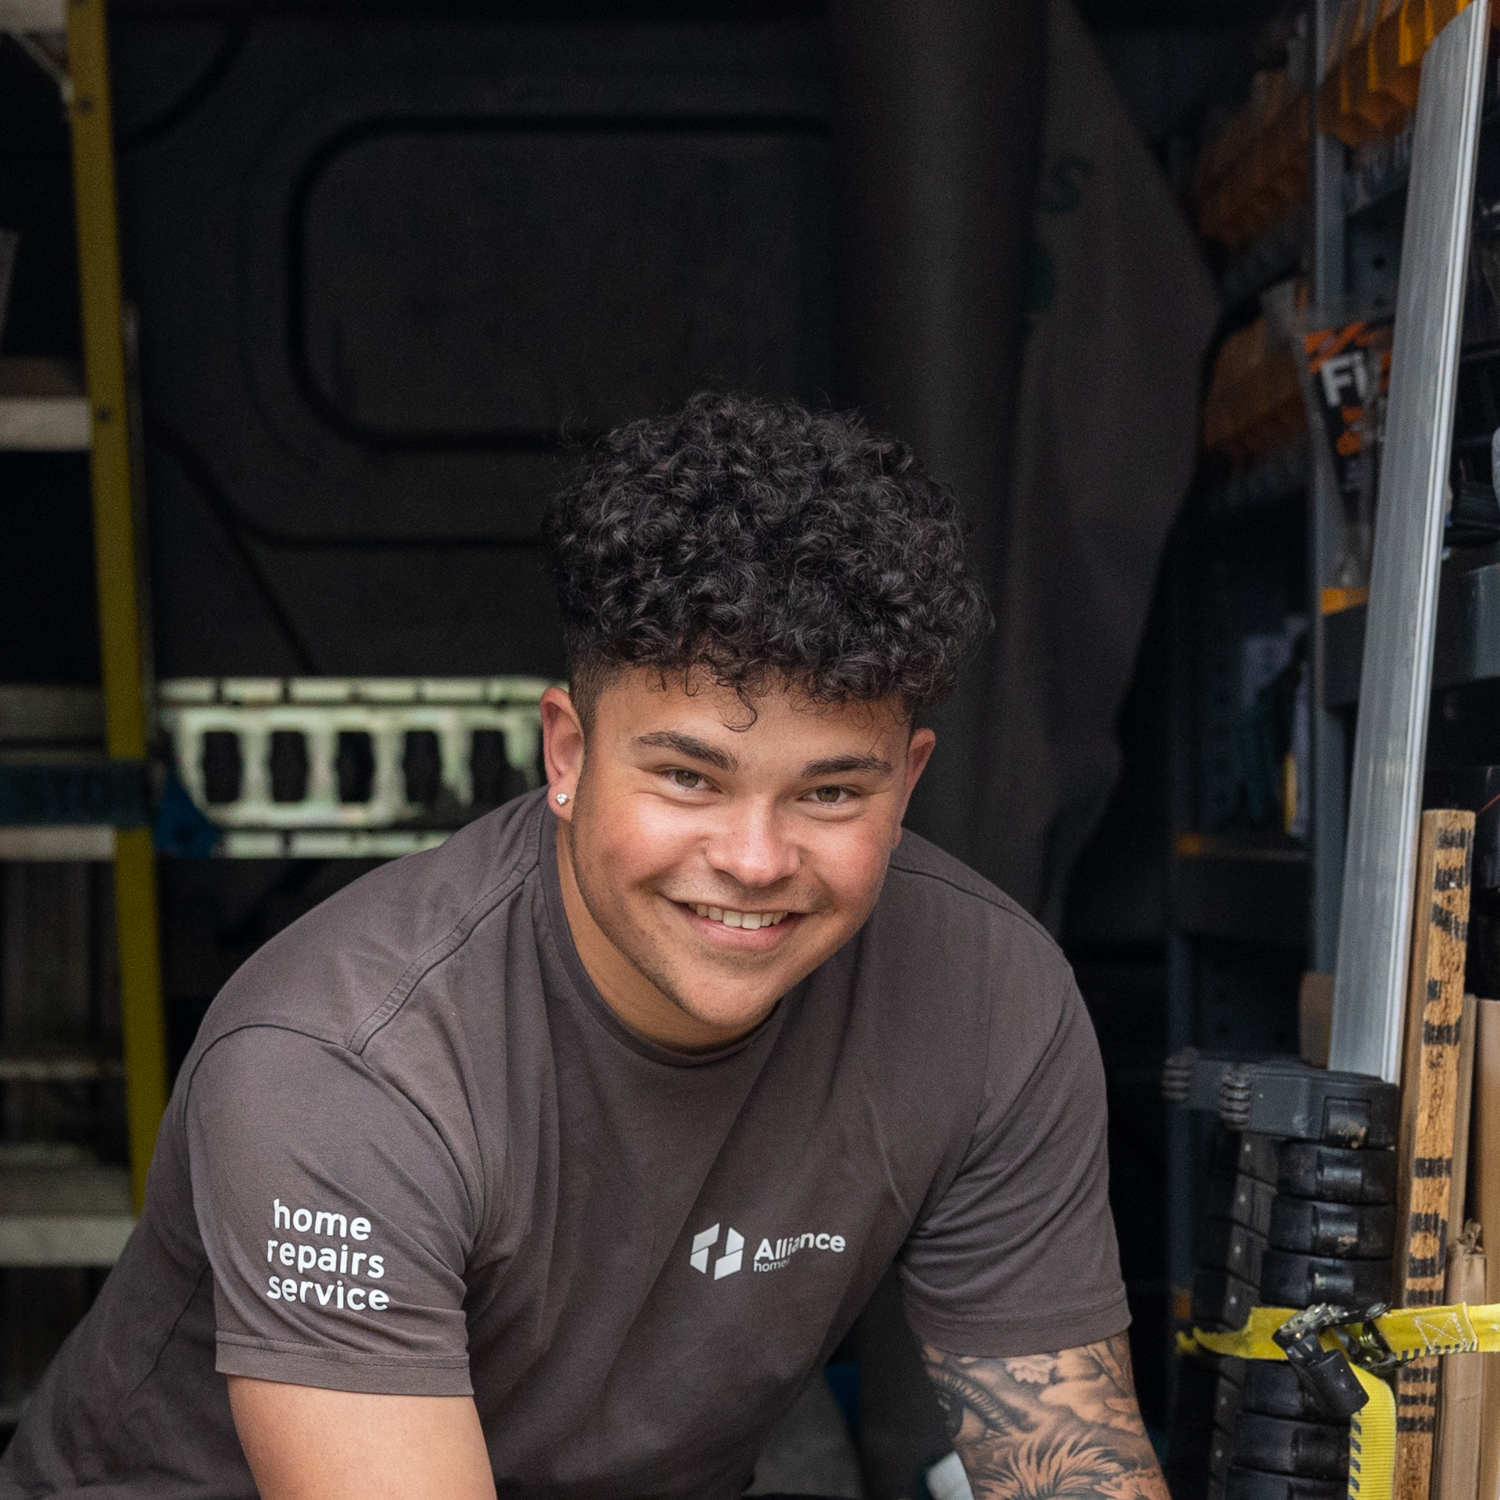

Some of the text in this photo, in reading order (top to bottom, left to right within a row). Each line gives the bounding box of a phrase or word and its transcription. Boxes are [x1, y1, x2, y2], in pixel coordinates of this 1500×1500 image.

[273, 1198, 372, 1241] home
[266, 1239, 385, 1279] repairs
[753, 1232, 846, 1260] Alliance
[266, 1275, 390, 1311] service
